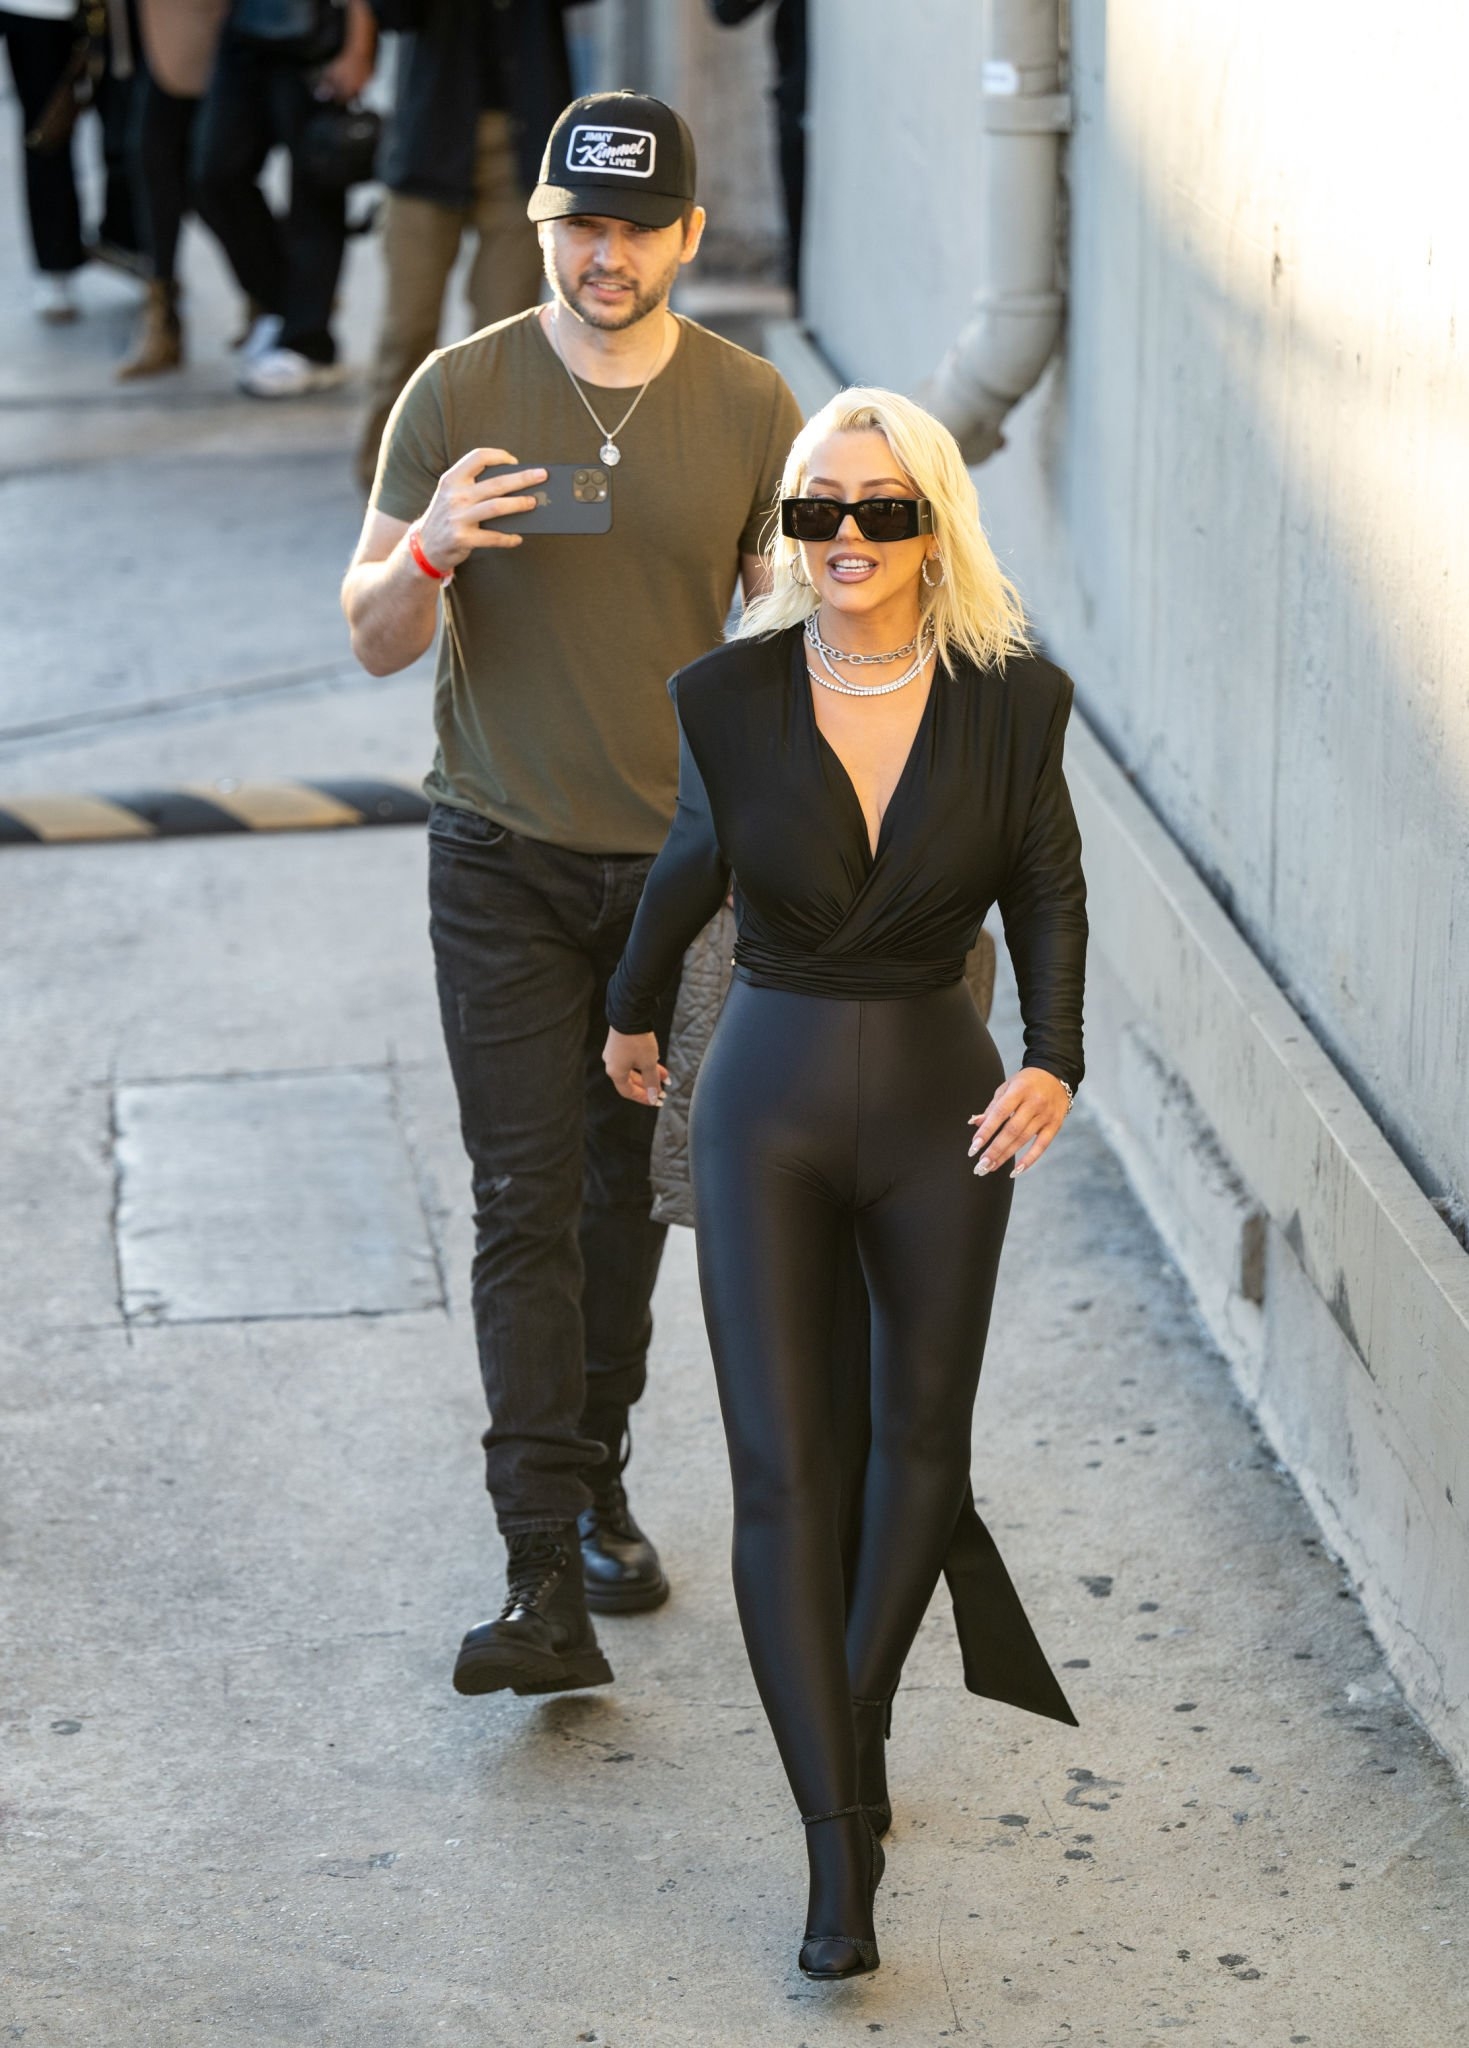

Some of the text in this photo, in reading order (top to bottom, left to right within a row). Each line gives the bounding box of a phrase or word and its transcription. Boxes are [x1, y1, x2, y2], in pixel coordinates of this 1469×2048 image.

[582, 132, 613, 142] JIMMY
[576, 138, 646, 166] Kimmel
[609, 158, 636, 168] LIVE!
